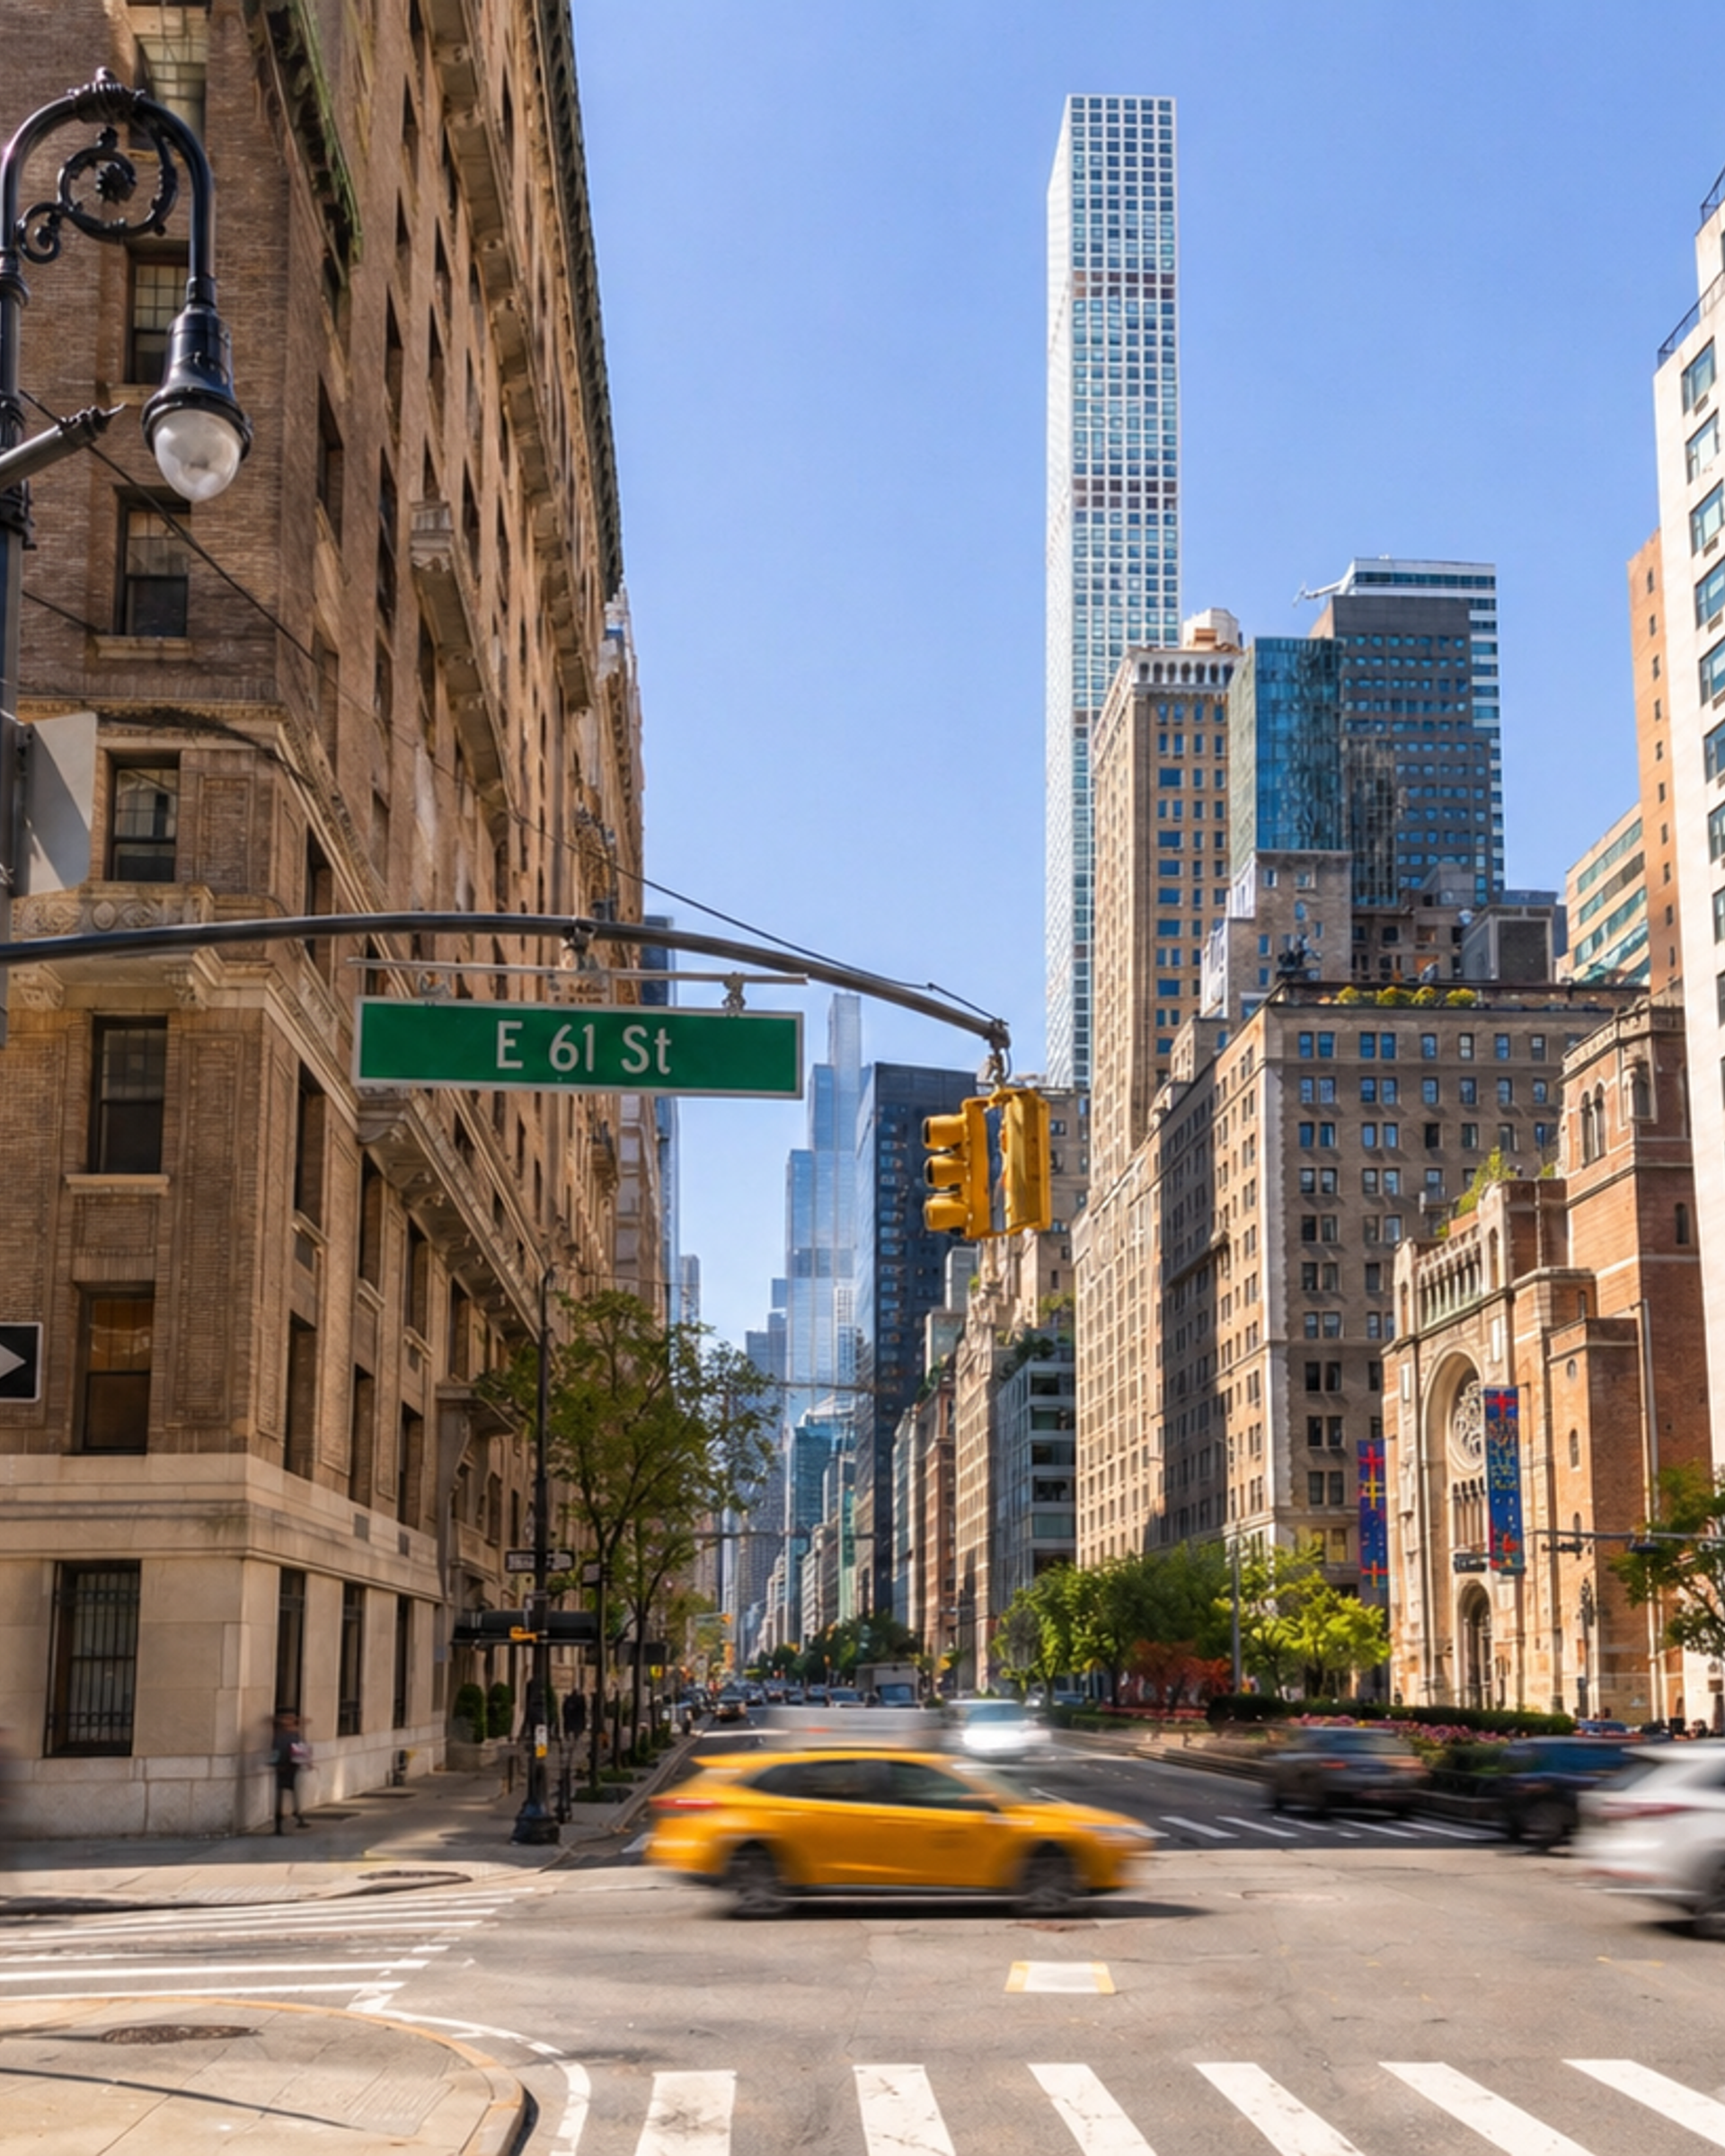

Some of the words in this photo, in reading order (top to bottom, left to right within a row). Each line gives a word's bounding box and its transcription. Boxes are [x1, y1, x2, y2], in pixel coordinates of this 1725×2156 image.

[497, 1021, 523, 1069] E
[549, 1023, 594, 1072] 61
[621, 1024, 672, 1074] St
